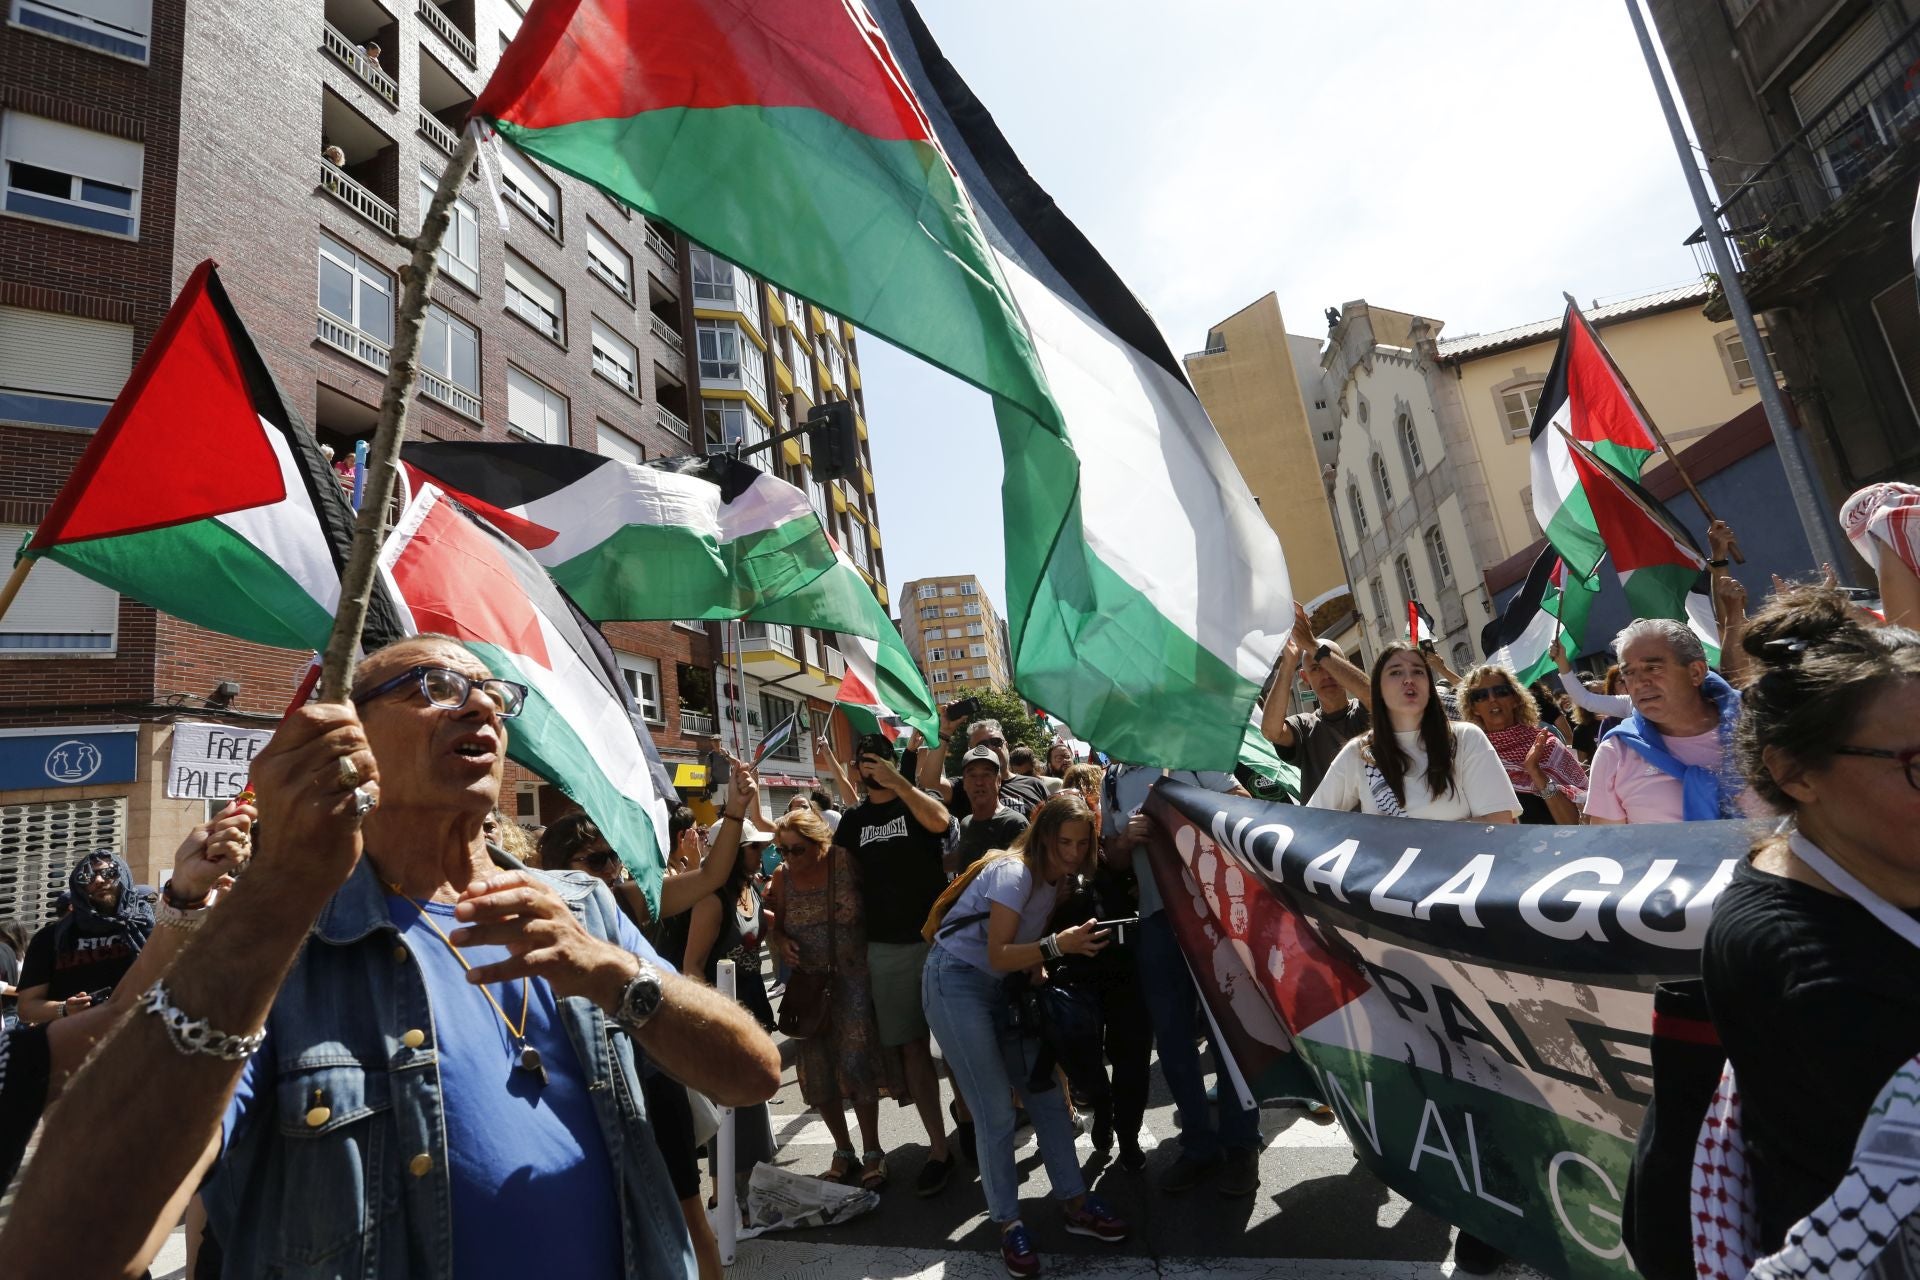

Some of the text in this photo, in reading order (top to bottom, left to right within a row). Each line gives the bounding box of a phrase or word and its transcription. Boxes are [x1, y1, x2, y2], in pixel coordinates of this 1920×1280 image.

[207, 731, 261, 761] FREE
[1212, 811, 1739, 950] NO A LA GU
[1363, 960, 1655, 1106] PALE
[1409, 1098, 1524, 1218] AL
